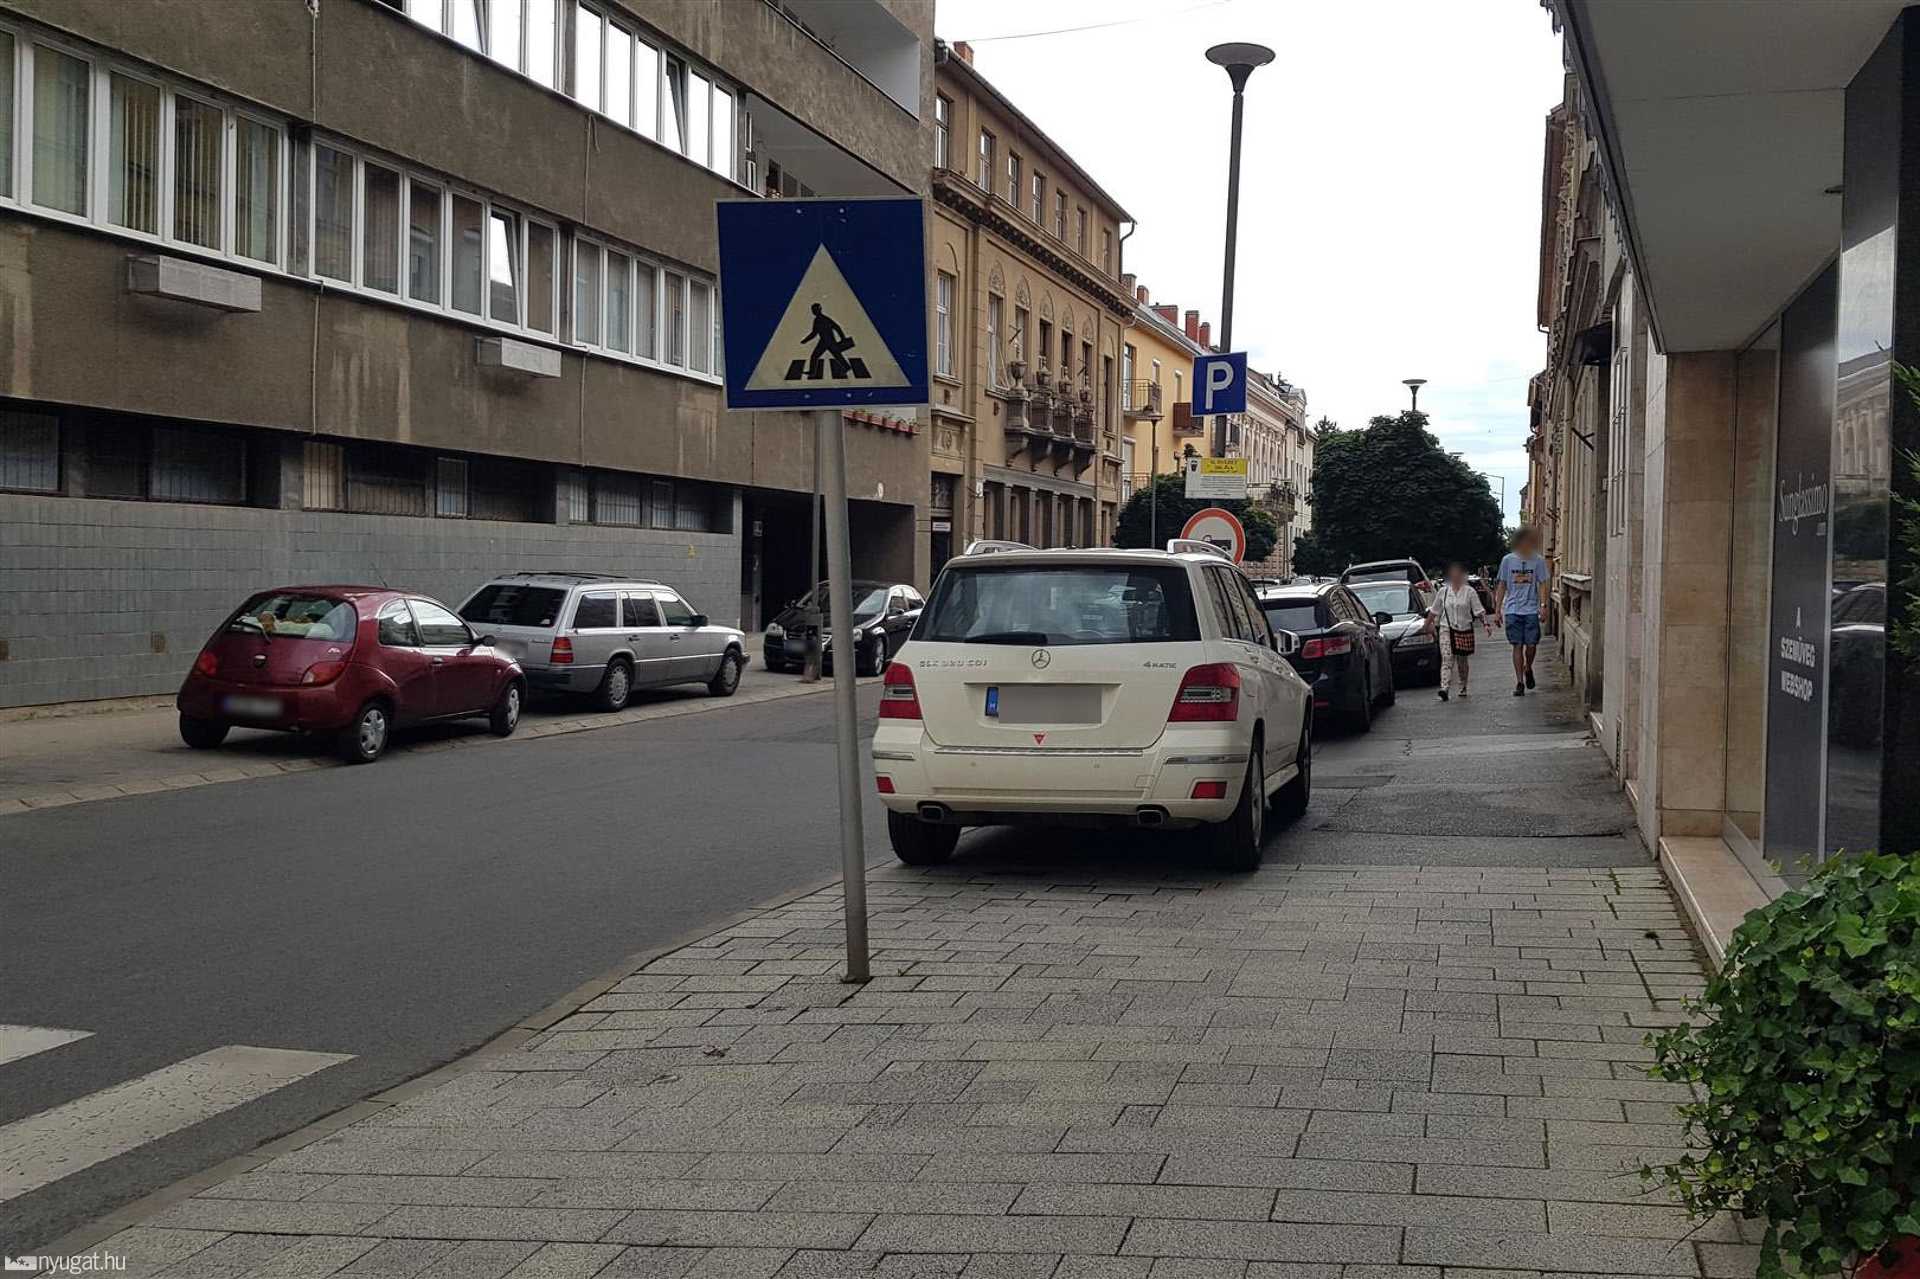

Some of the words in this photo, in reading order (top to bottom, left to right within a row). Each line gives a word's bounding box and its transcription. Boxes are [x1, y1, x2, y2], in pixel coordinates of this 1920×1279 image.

[1205, 361, 1234, 410] P
[1795, 607, 1802, 629] A
[1781, 670, 1813, 702] WEBSHOP
